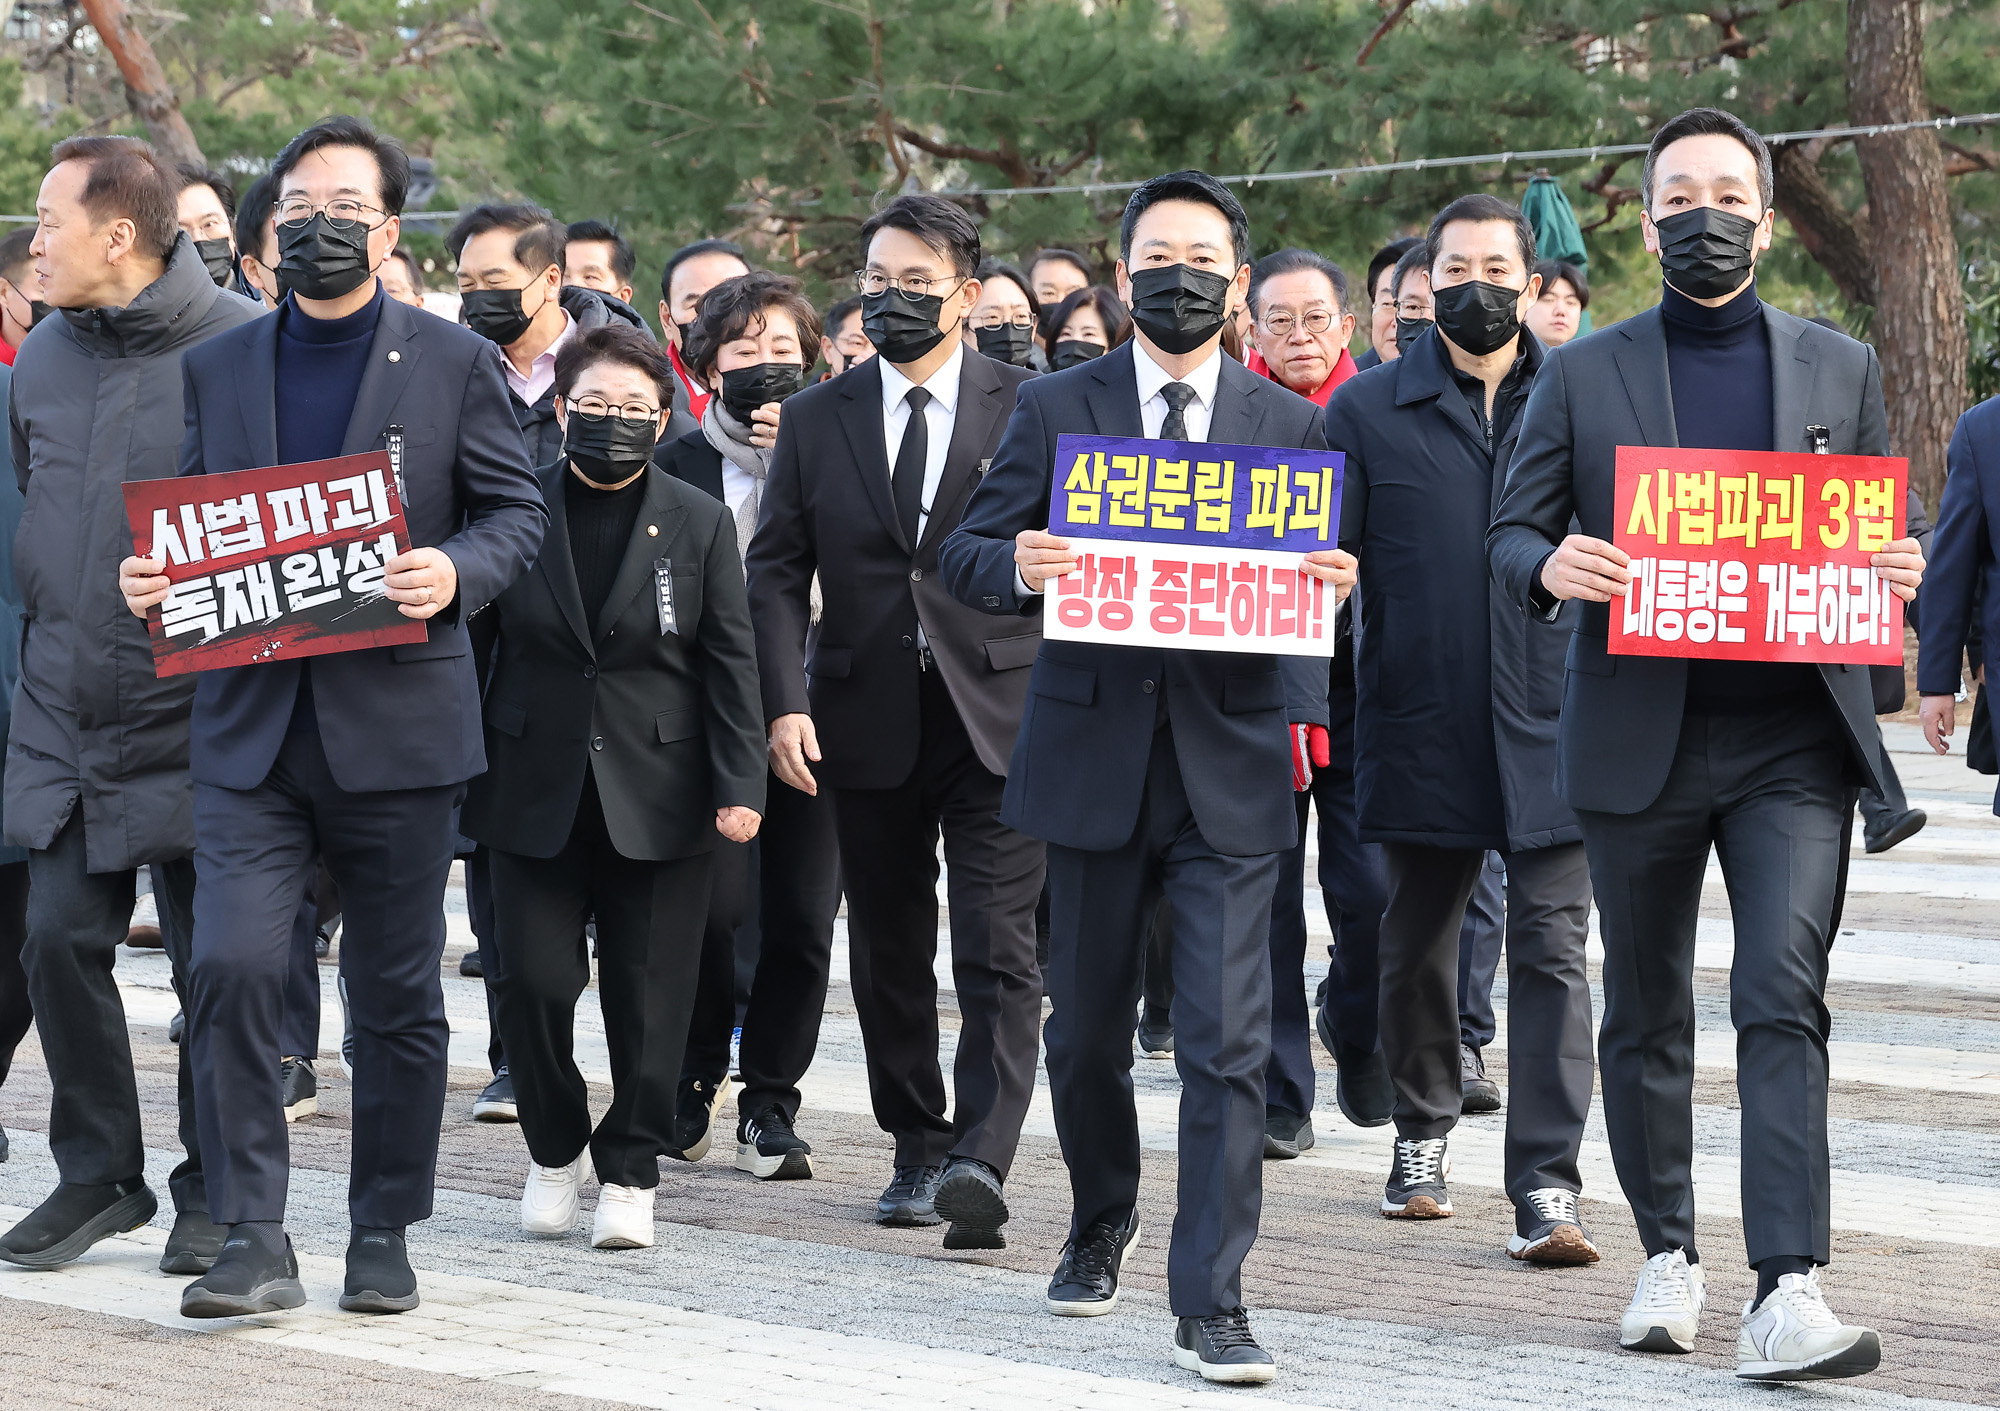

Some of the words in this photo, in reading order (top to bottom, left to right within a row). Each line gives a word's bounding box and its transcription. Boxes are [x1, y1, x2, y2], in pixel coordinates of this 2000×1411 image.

[150, 493, 267, 567] 사법
[265, 468, 394, 543] 파괴
[1063, 451, 1236, 534] 삼권분립
[1245, 464, 1334, 542] 파괴
[1625, 468, 1806, 550] 사법파괴
[1818, 477, 1896, 553] 3법
[160, 561, 280, 639] 독재
[280, 531, 399, 613] 완성
[1057, 553, 1138, 632] 당장
[1149, 559, 1325, 640] 중단하라!
[1621, 556, 1750, 644] 대통령은
[1757, 562, 1892, 647] 거부하라!
